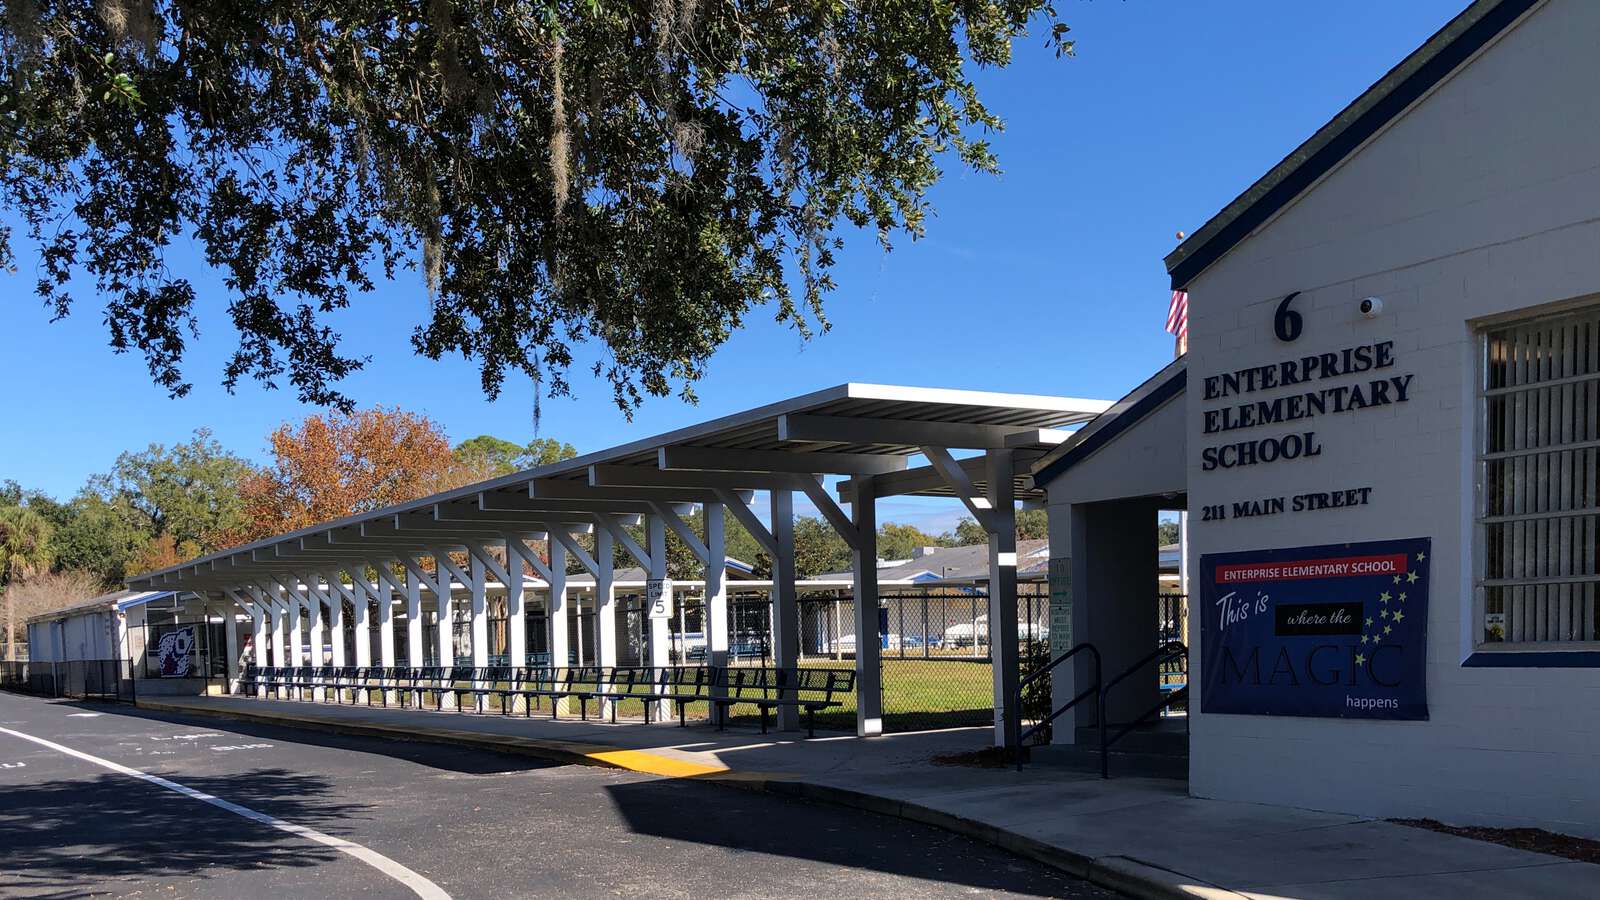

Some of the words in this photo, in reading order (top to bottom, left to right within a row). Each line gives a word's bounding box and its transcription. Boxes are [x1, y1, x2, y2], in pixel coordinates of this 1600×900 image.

[1274, 291, 1303, 341] 6
[1203, 340, 1394, 401] ENTERPRISE
[1203, 374, 1414, 434] ELEMENTARY
[1202, 432, 1321, 471] SCHOOL
[1202, 504, 1225, 521] 211
[1233, 497, 1284, 518] MAIN
[1292, 487, 1372, 512] STREET
[1224, 567, 1280, 581] ENTERPRISE
[1282, 563, 1349, 577] ELEMENTARY
[1351, 560, 1396, 573] SCHOOL
[656, 600, 664, 614] 5
[1216, 591, 1249, 631] This
[1255, 591, 1269, 615] is
[1287, 610, 1327, 625] where
[1330, 609, 1352, 624] the
[1220, 645, 1403, 688] MAGIC
[1346, 695, 1399, 711] happens
